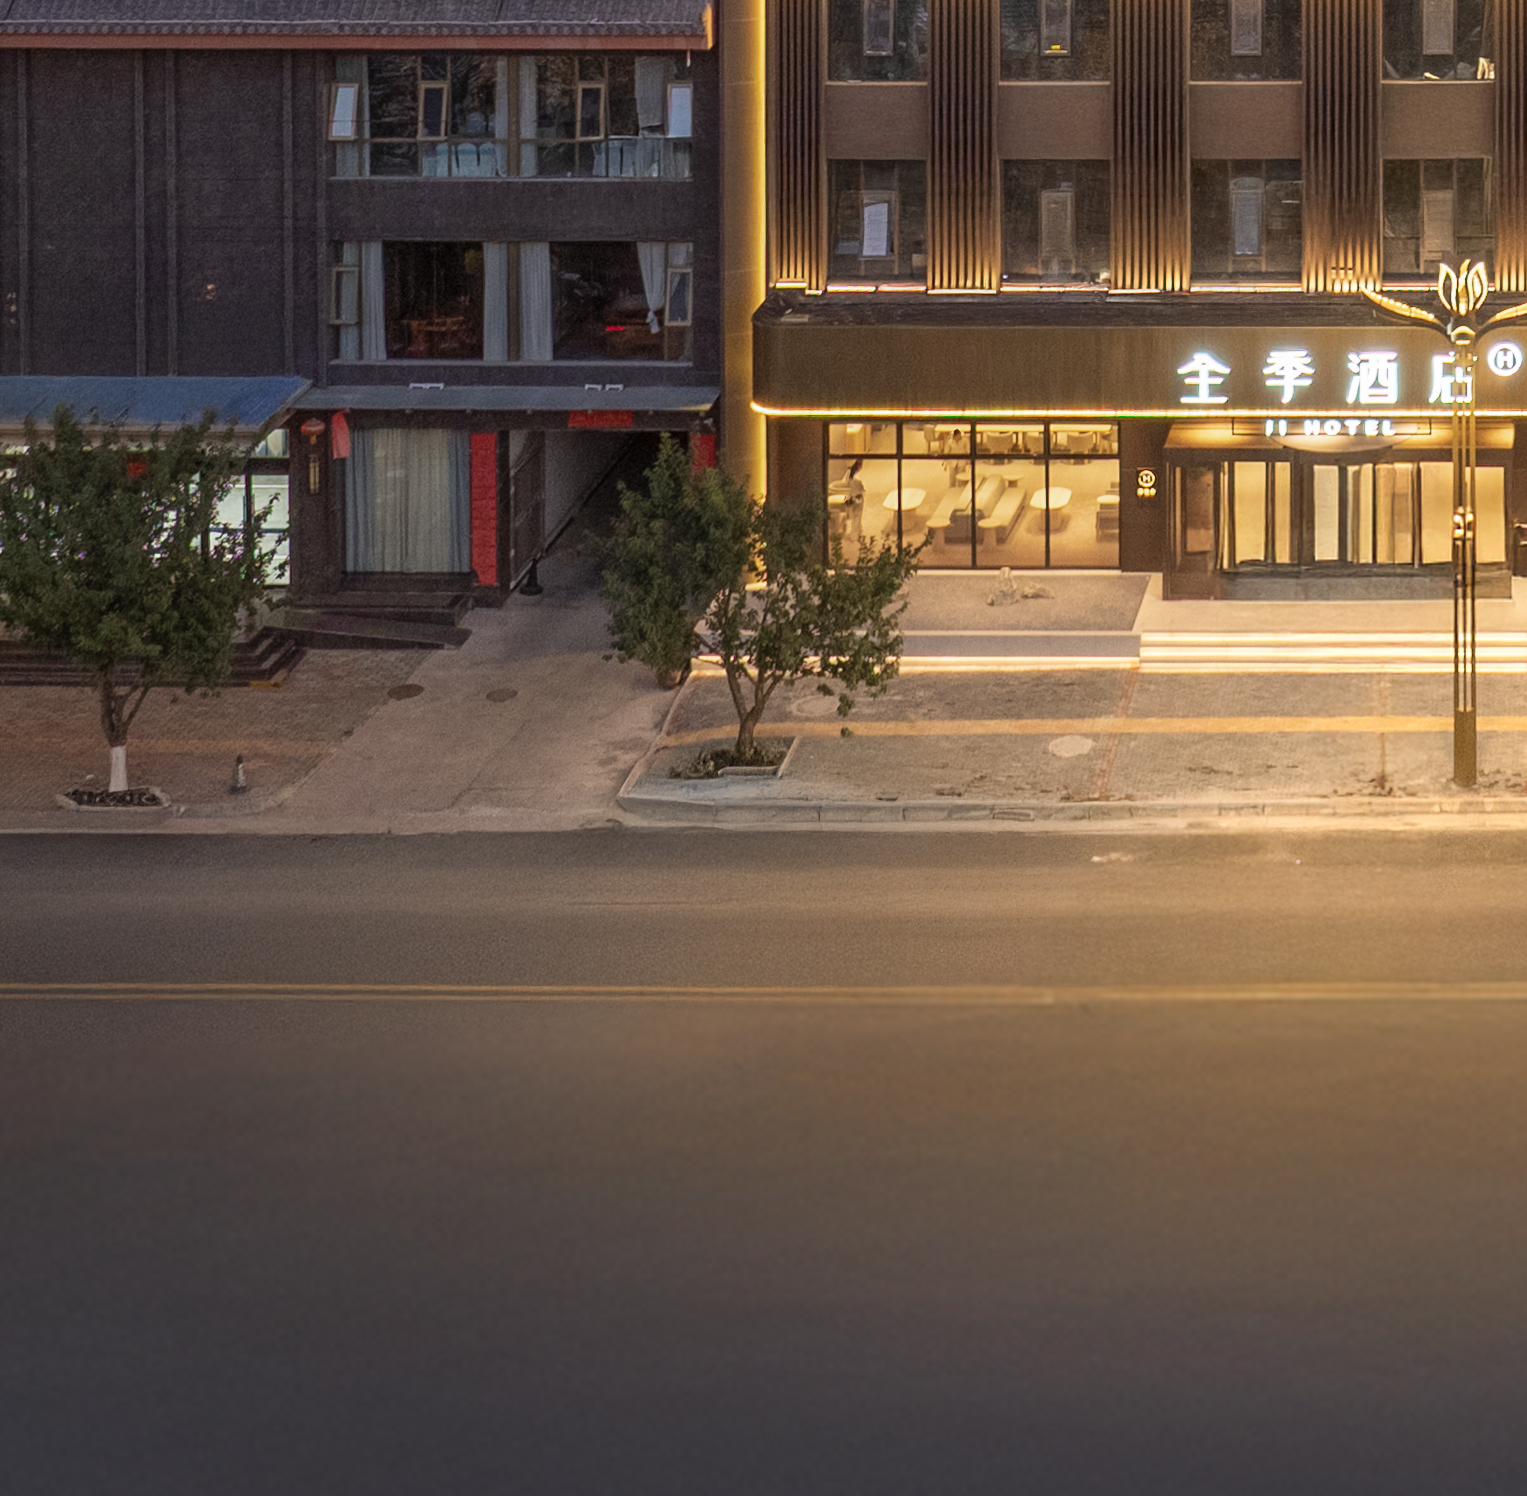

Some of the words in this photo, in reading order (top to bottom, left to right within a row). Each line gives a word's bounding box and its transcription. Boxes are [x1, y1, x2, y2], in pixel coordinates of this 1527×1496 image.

[1176, 349, 1477, 404] 全季酒店
[1304, 418, 1396, 437] HOTEL
